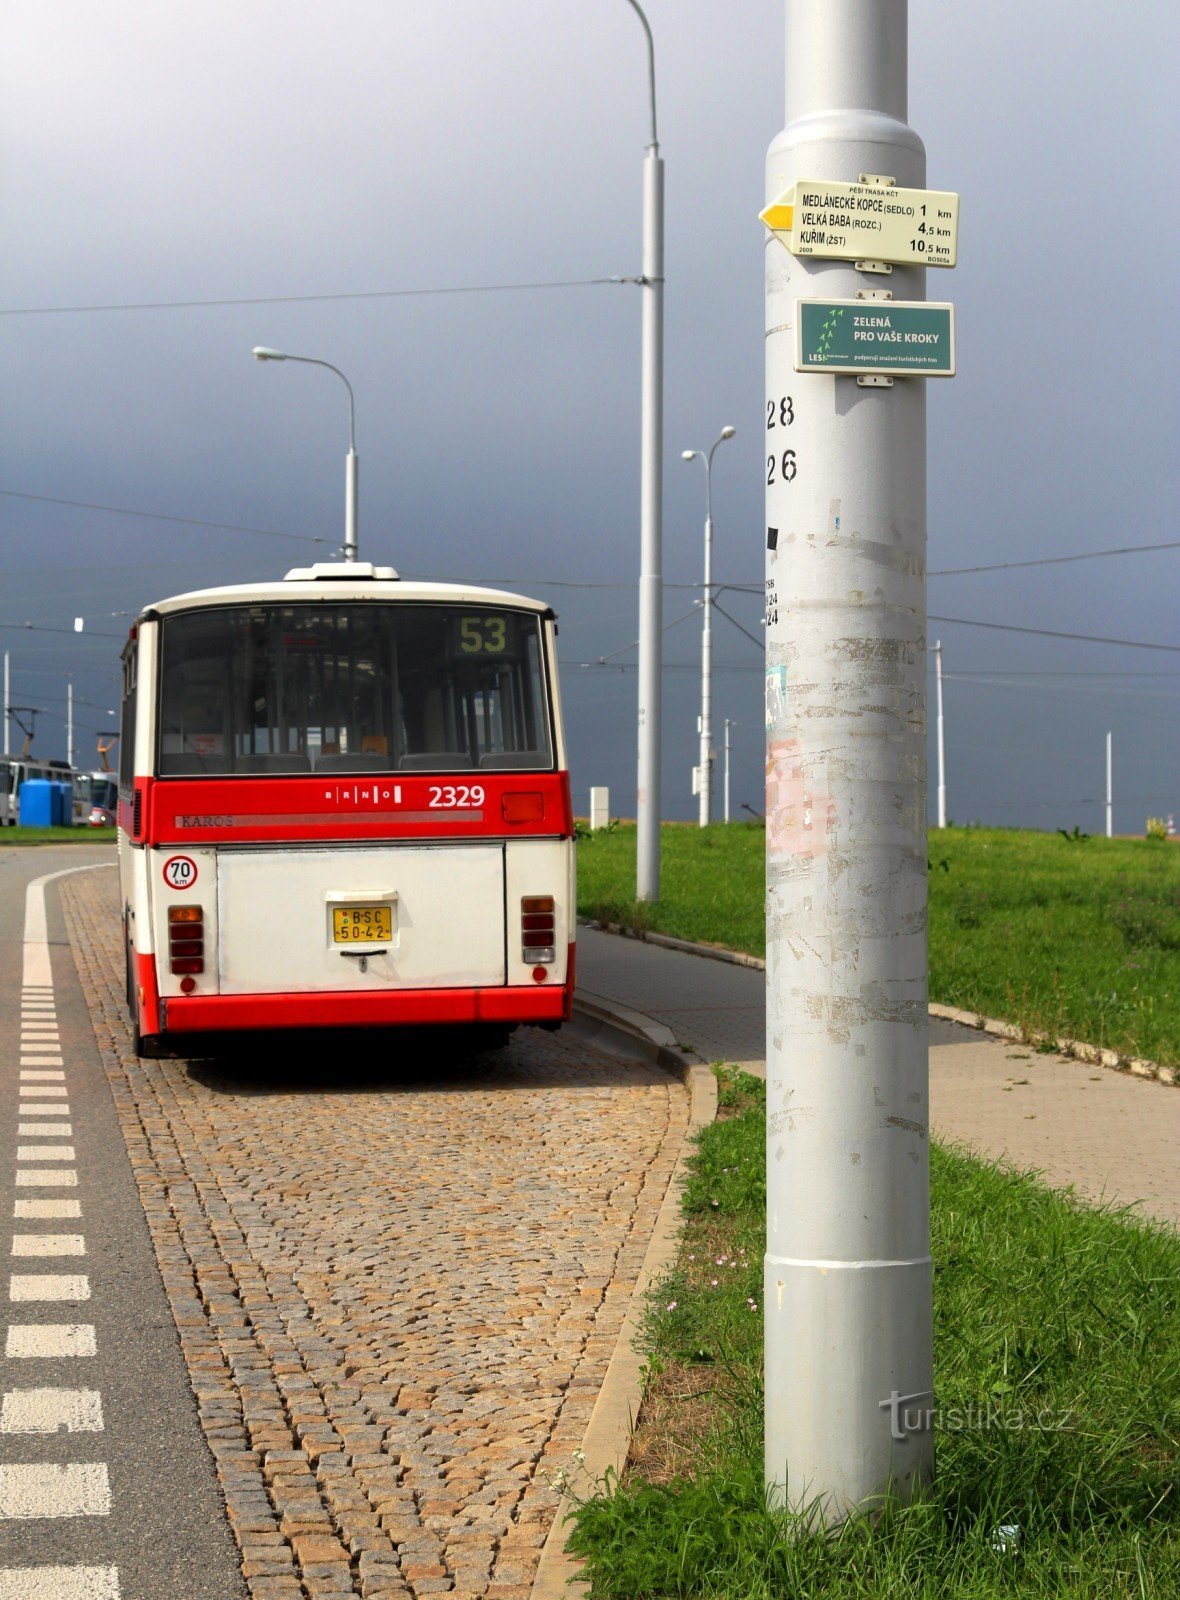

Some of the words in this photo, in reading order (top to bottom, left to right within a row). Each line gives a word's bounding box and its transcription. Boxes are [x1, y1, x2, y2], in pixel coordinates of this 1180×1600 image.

[802, 193, 855, 209] MEDLÁNECKÉ
[856, 198, 883, 212] KOPCE
[884, 204, 915, 218] (SEDLO)
[920, 204, 926, 216] 1
[937, 209, 952, 219] km
[802, 211, 827, 226] VELKÁ
[829, 214, 851, 227] BABA
[852, 219, 882, 232] (ROZC.)
[918, 222, 934, 236] 4,5
[936, 227, 951, 237] km
[800, 229, 825, 244] KUŘIM
[826, 235, 846, 247] (ŽST)
[910, 239, 933, 254] 10,5
[935, 245, 950, 255] km
[853, 316, 891, 328] ZELENÁ
[854, 331, 875, 341] PRO
[876, 330, 902, 342] VAŠE
[904, 333, 939, 344] KROKY
[767, 396, 794, 430] 28
[767, 449, 797, 486] 26
[461, 617, 506, 652] 53
[428, 785, 485, 807] 2329
[182, 815, 233, 828] KAROS
[171, 862, 190, 878] 70
